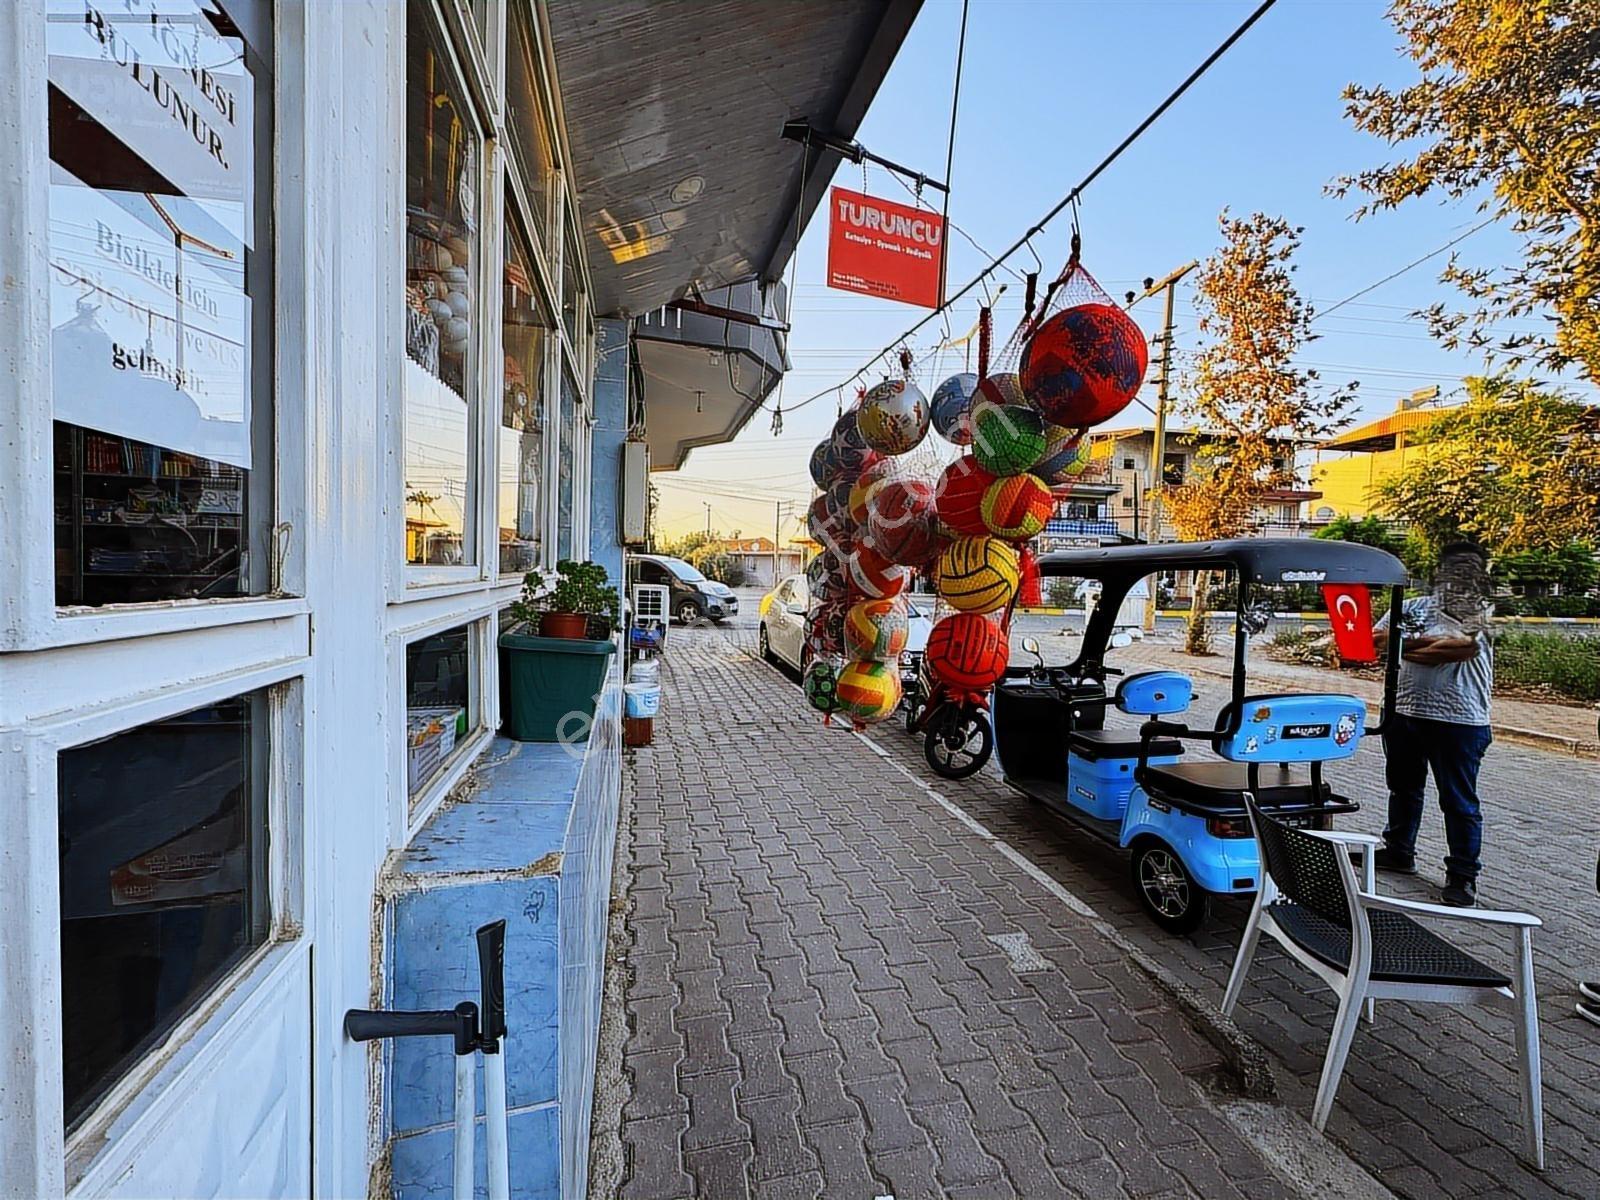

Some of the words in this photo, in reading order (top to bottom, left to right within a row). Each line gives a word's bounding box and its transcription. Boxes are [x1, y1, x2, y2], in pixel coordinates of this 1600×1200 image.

[838, 199, 942, 246] TURUNCU
[96, 218, 182, 296] Bisiklet
[187, 278, 218, 319] için
[112, 342, 208, 396] gelmiştir.
